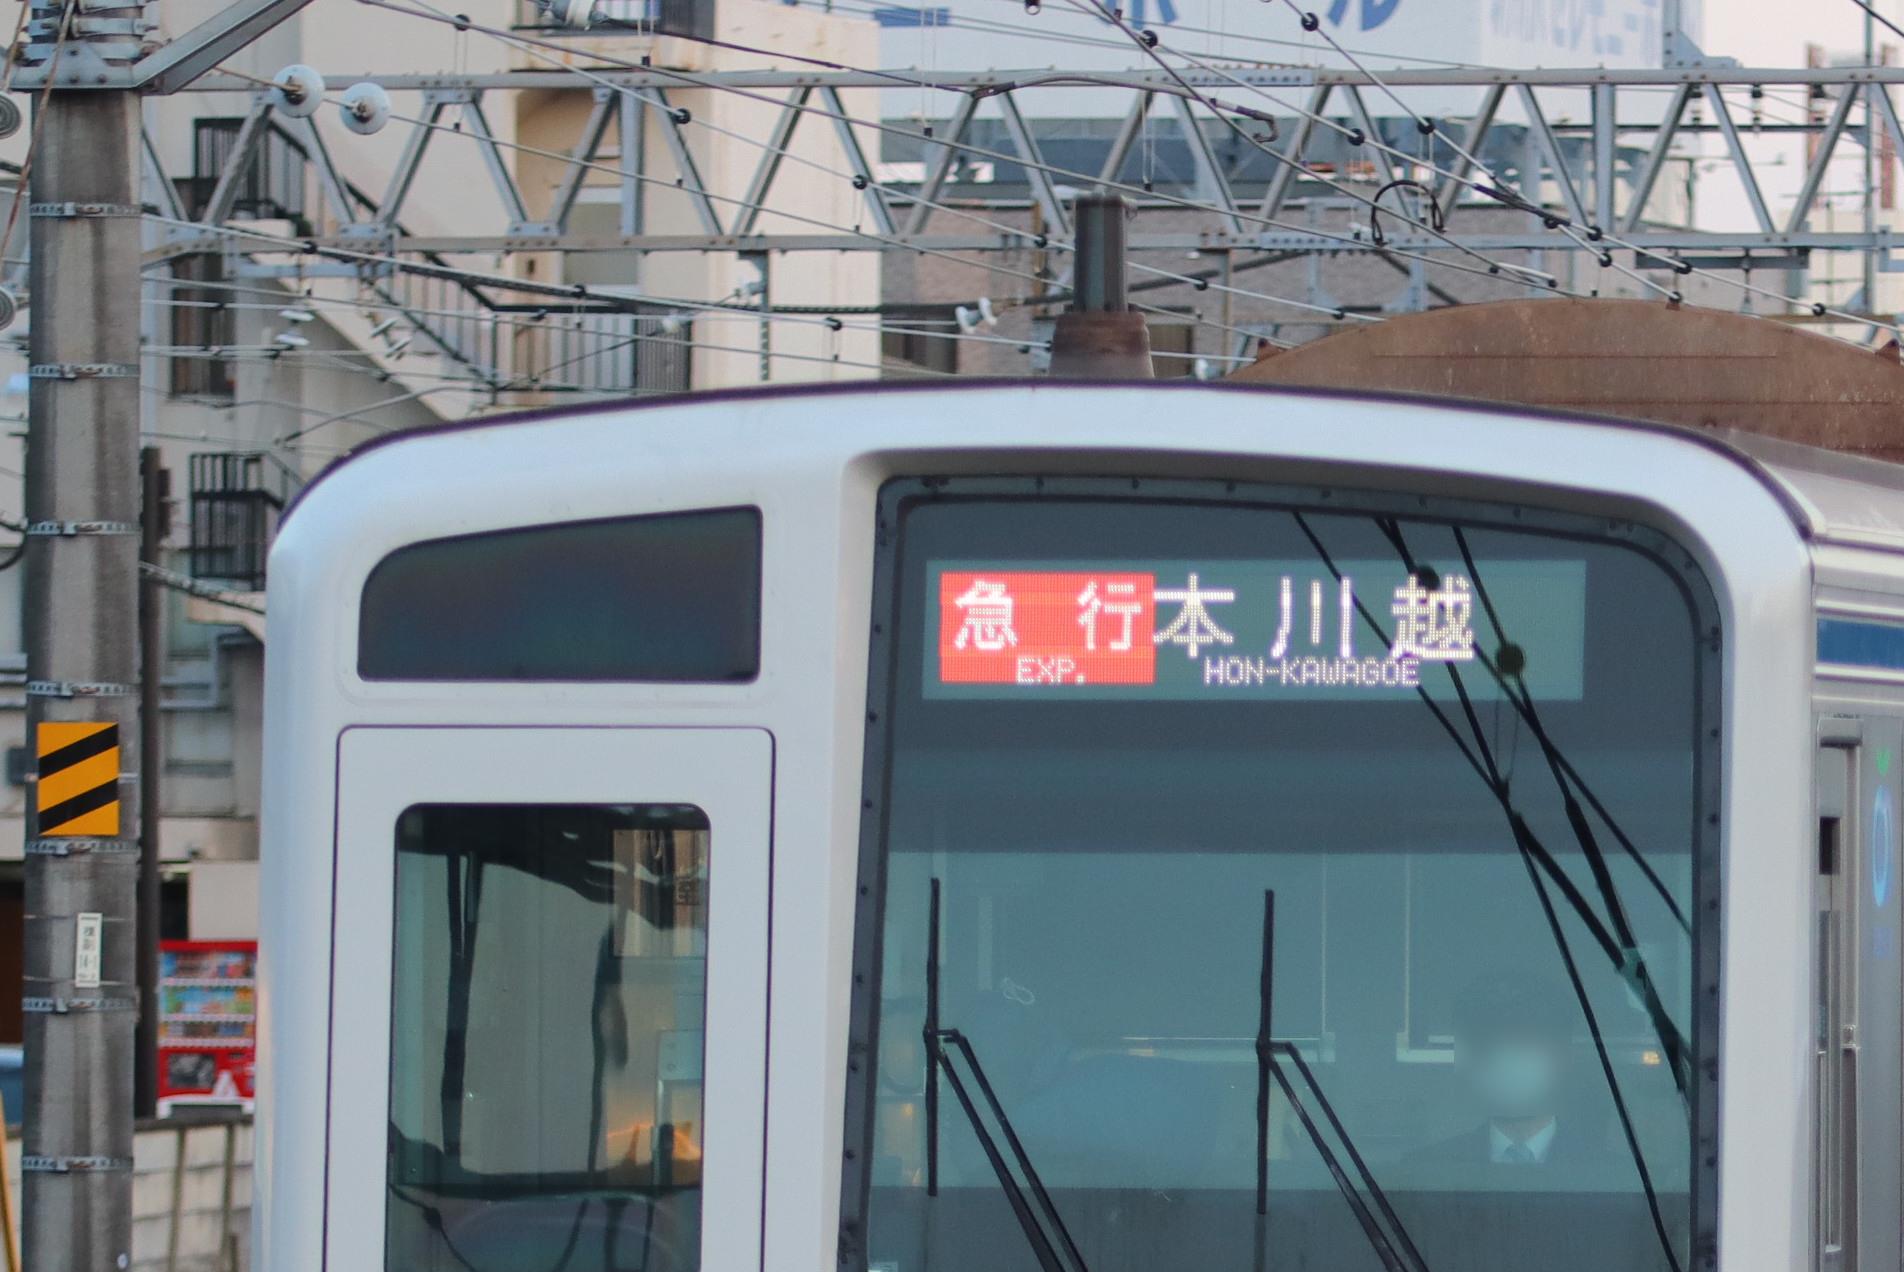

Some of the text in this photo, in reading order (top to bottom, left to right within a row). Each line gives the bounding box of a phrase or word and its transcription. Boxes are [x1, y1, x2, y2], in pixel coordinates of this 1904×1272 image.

[954, 580, 1143, 650] 急行
[1153, 573, 1476, 662] 本川越
[1015, 658, 1087, 684] EXP.
[1204, 660, 1421, 687] HON-KAWAGOE
